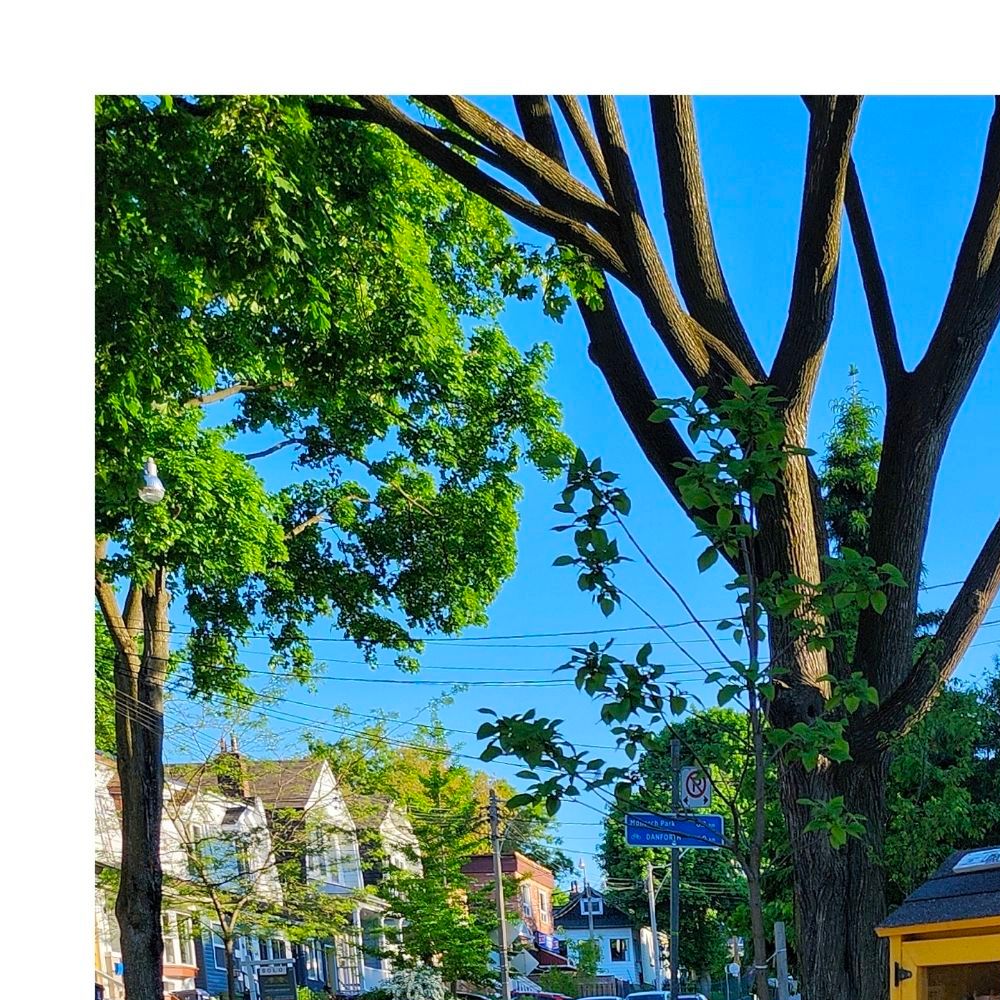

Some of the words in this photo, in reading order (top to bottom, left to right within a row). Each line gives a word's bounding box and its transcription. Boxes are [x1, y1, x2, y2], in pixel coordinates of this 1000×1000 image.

[630, 819, 659, 827] Monrch
[660, 819, 676, 827] Park
[646, 833, 682, 841] DANFORTH
